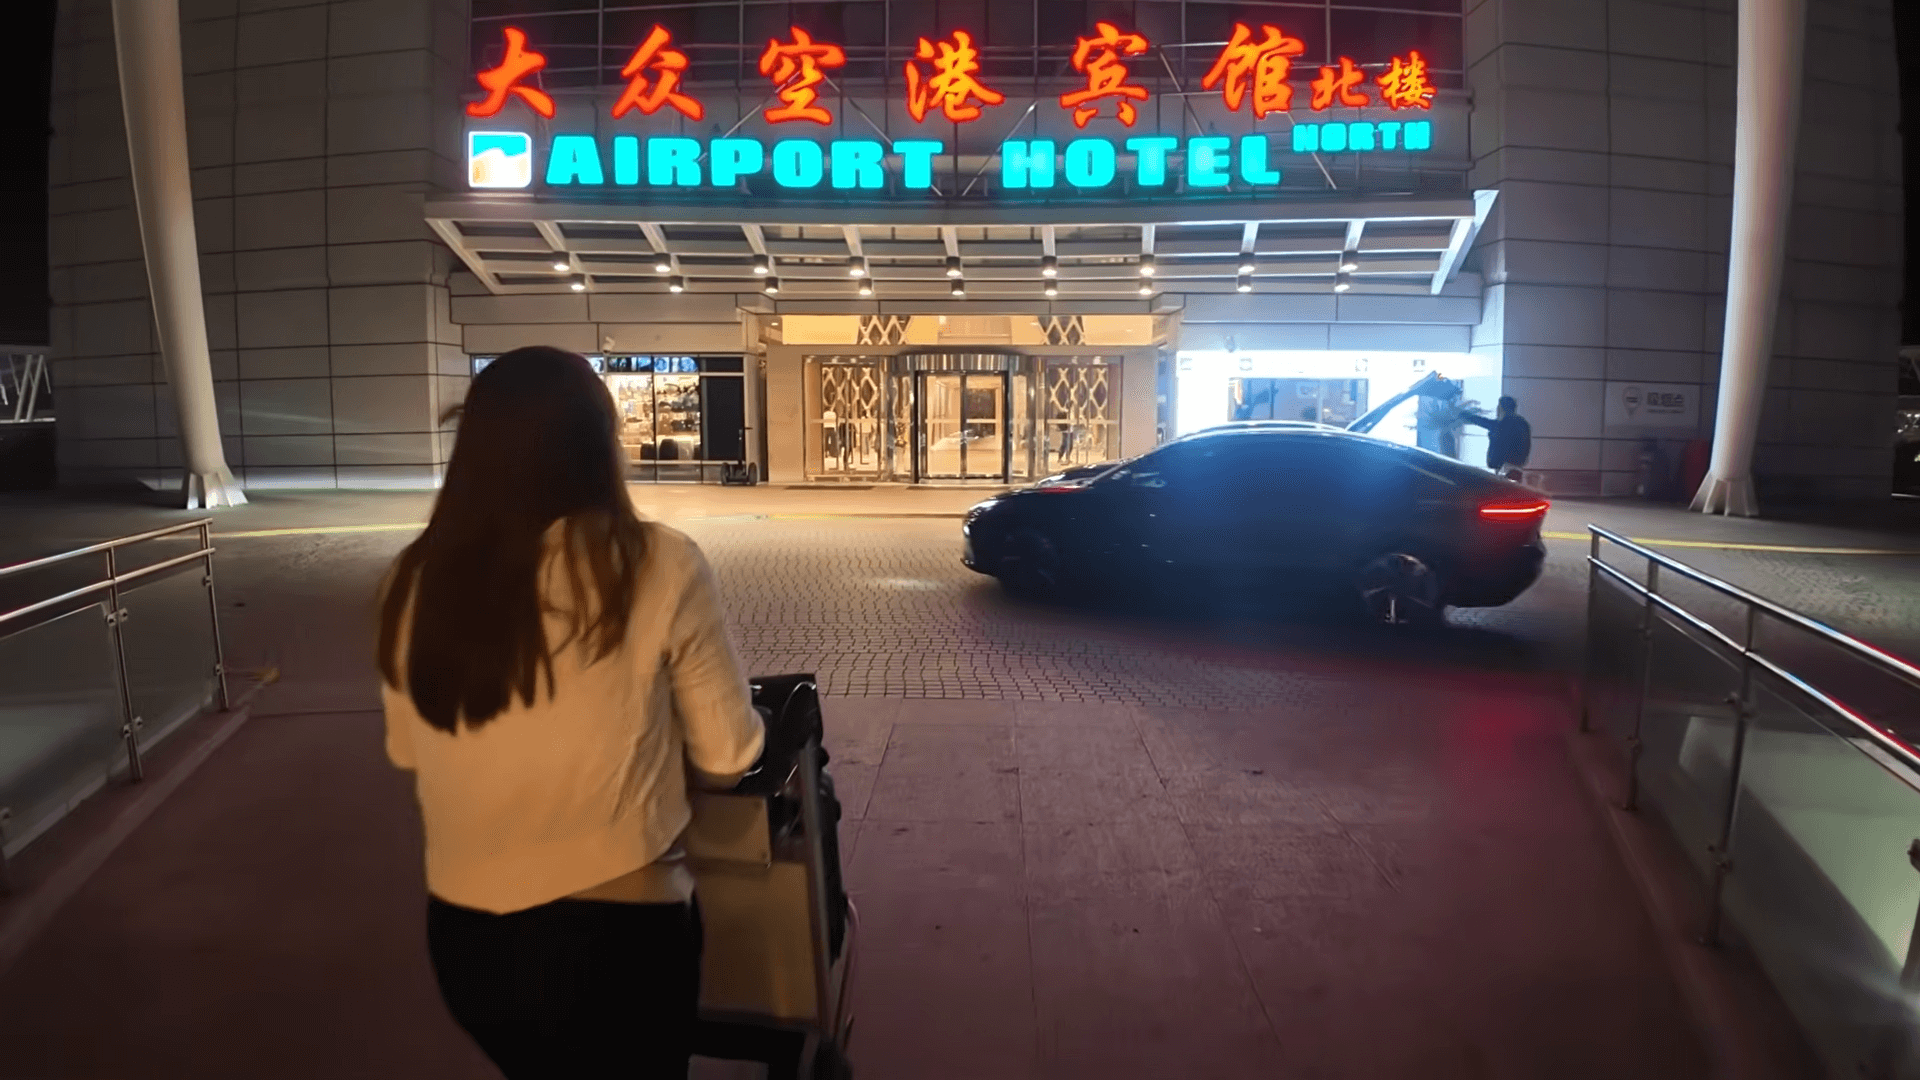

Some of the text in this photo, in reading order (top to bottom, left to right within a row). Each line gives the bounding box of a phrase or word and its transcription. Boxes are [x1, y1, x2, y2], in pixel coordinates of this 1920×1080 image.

[466, 22, 1437, 128] 大众空港宾馆 北楼
[546, 121, 1430, 189] AIRPORT HOTEL NORTH
